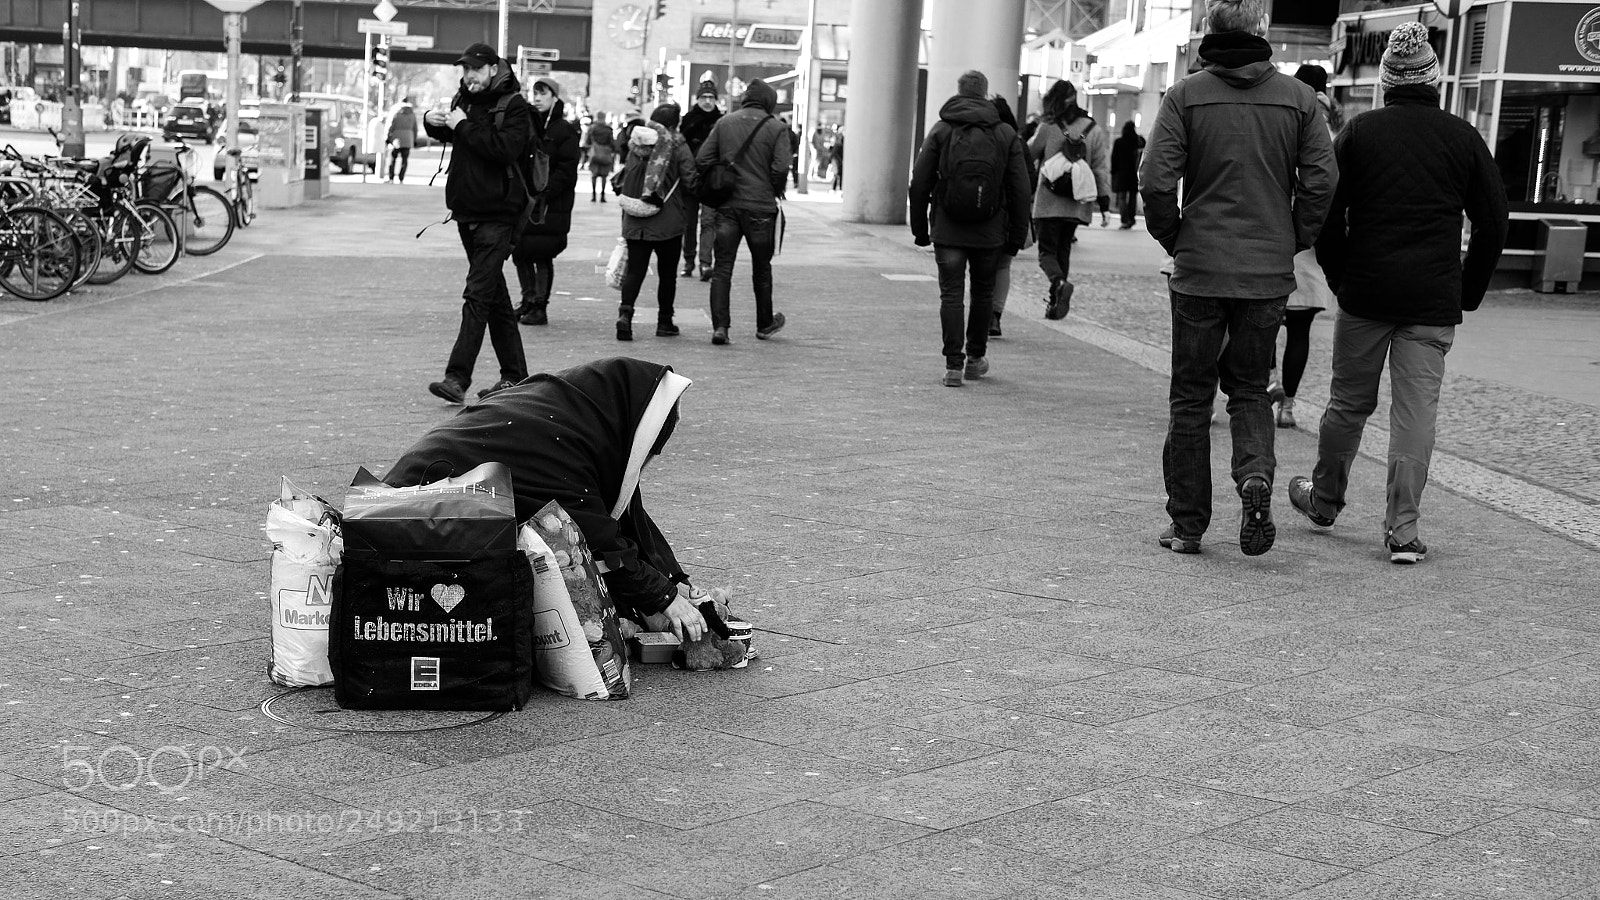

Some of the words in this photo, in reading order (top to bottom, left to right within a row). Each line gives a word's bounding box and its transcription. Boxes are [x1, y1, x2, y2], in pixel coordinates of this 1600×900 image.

[701, 23, 748, 39] Reise
[1558, 64, 1600, 72] www.wu
[305, 574, 334, 606] N
[386, 586, 425, 611] Wir
[354, 615, 498, 643] Lebensmittel.
